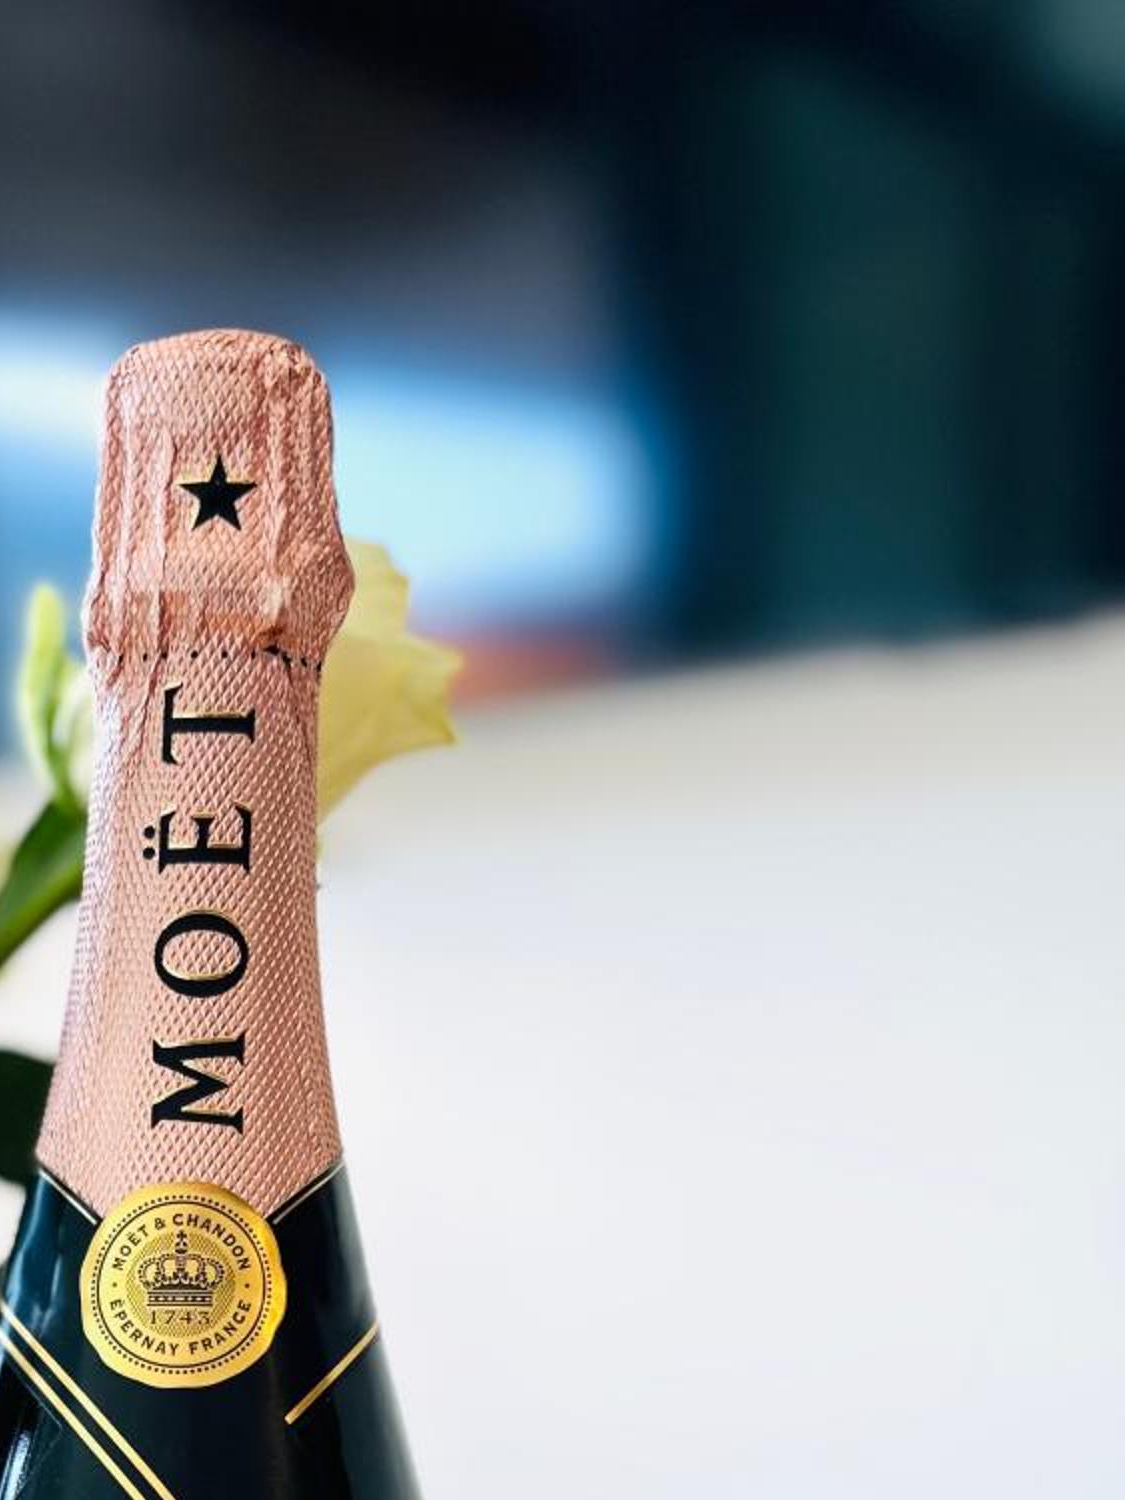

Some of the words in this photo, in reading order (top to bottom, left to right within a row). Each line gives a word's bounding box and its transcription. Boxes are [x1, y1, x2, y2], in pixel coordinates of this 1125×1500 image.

[142, 682, 257, 1135] MOËT
[112, 1224, 153, 1271] MOËT
[154, 1217, 167, 1230] &
[172, 1213, 251, 1271] CHANDON
[150, 1310, 211, 1325] 1743
[189, 1299, 252, 1355] FRANCE
